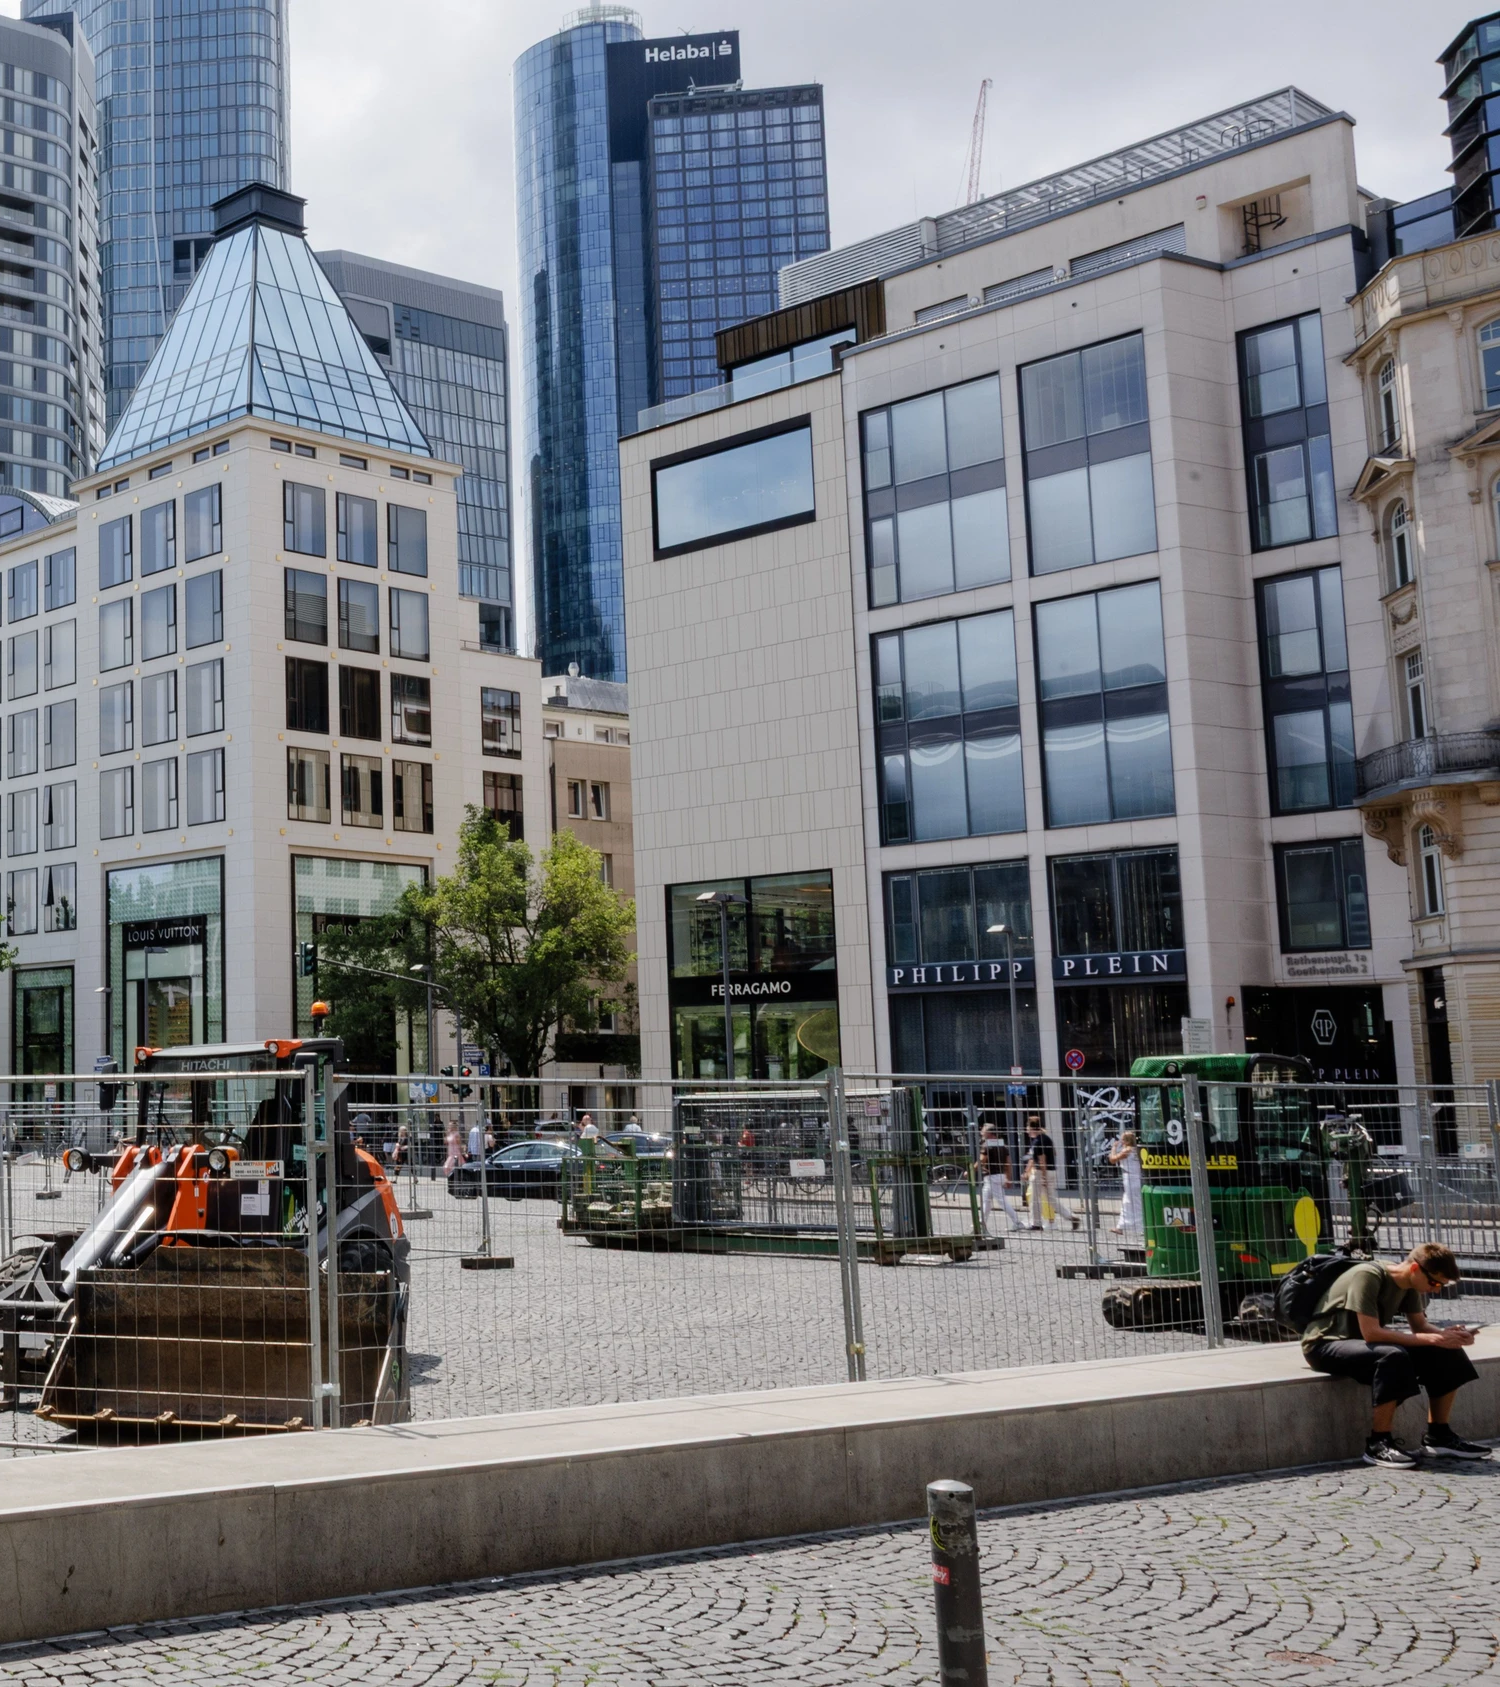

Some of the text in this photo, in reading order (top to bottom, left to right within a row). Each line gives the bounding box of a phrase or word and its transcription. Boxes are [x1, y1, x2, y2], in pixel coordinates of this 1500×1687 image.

[645, 44, 710, 63] Helaba
[128, 925, 199, 942] LOUIS VUITTON
[893, 954, 1170, 984] PHILIPP PLEIN
[711, 980, 791, 996] FERRAGAMO
[181, 1060, 230, 1071] HITACHI
[1334, 1068, 1380, 1080] PLEIN
[1166, 1119, 1183, 1145] 9
[1163, 1207, 1190, 1225] CAT
